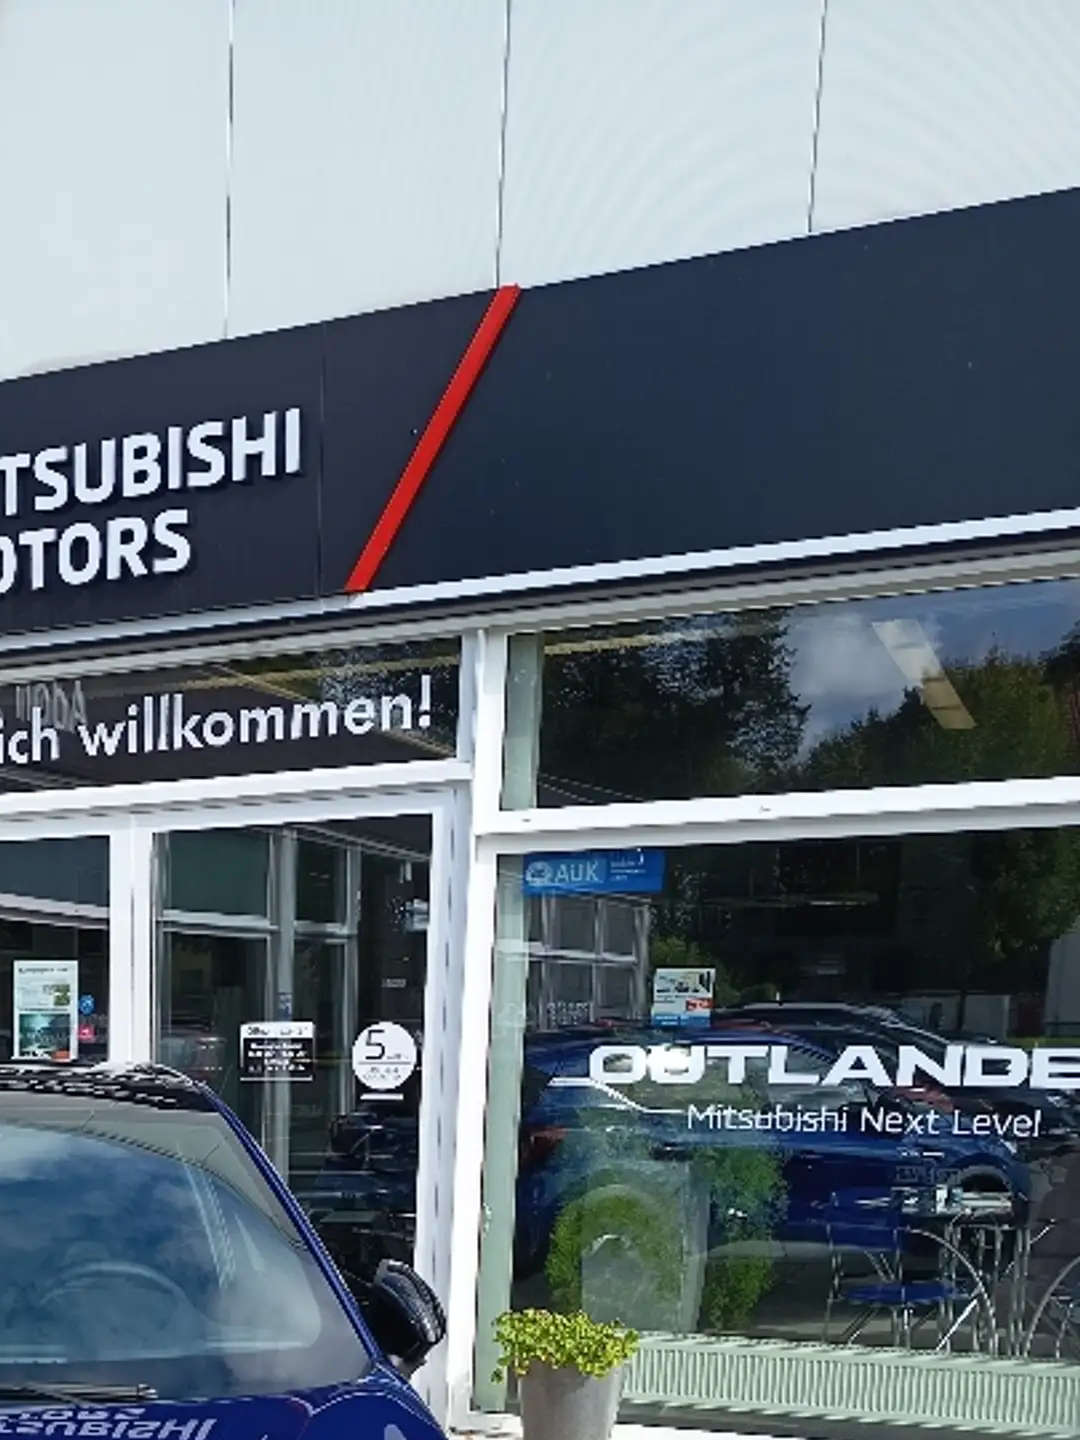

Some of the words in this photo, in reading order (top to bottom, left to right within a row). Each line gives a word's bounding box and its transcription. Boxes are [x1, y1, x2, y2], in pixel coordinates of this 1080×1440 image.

[78, 674, 432, 757] willkommen!
[365, 1029, 386, 1060] 5
[687, 1104, 847, 1134] Mitsubishi
[860, 1105, 940, 1135] Next
[953, 1110, 1042, 1138] Level
